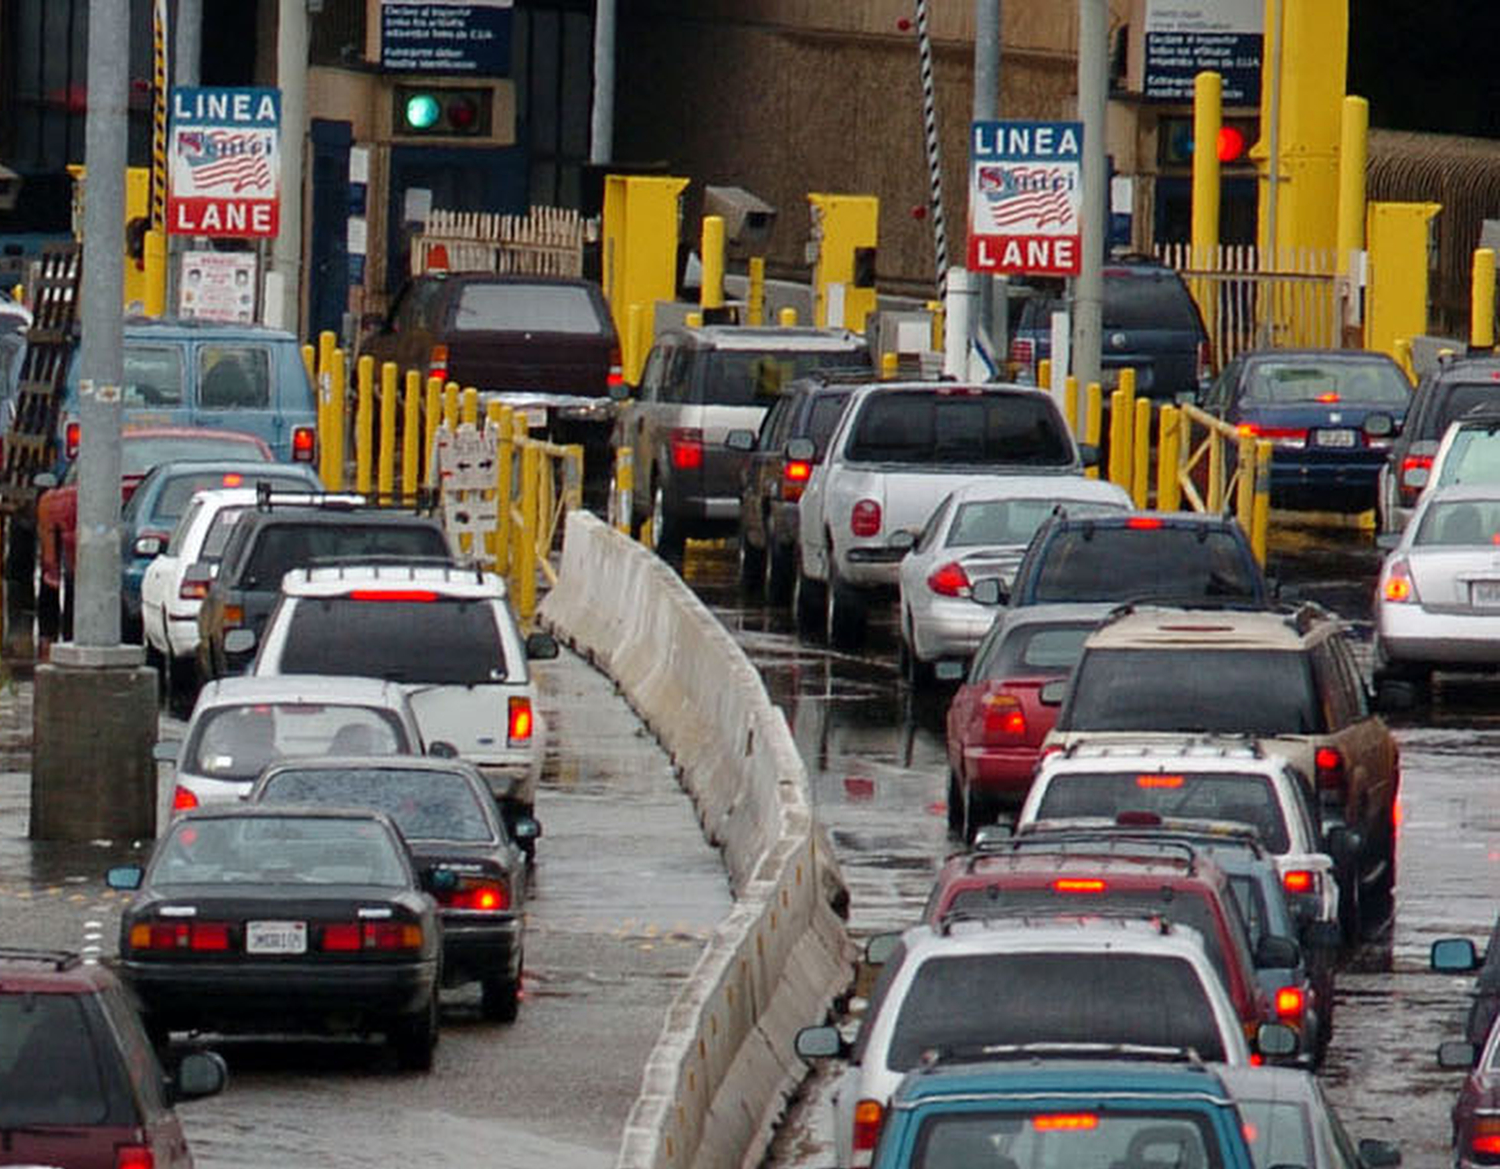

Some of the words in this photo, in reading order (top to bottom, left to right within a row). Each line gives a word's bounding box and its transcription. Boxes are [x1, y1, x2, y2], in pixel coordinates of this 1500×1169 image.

[175, 94, 276, 121] LINEA
[975, 127, 1078, 154] LINEA
[177, 203, 272, 231] LANE
[978, 240, 1074, 268] LANE
